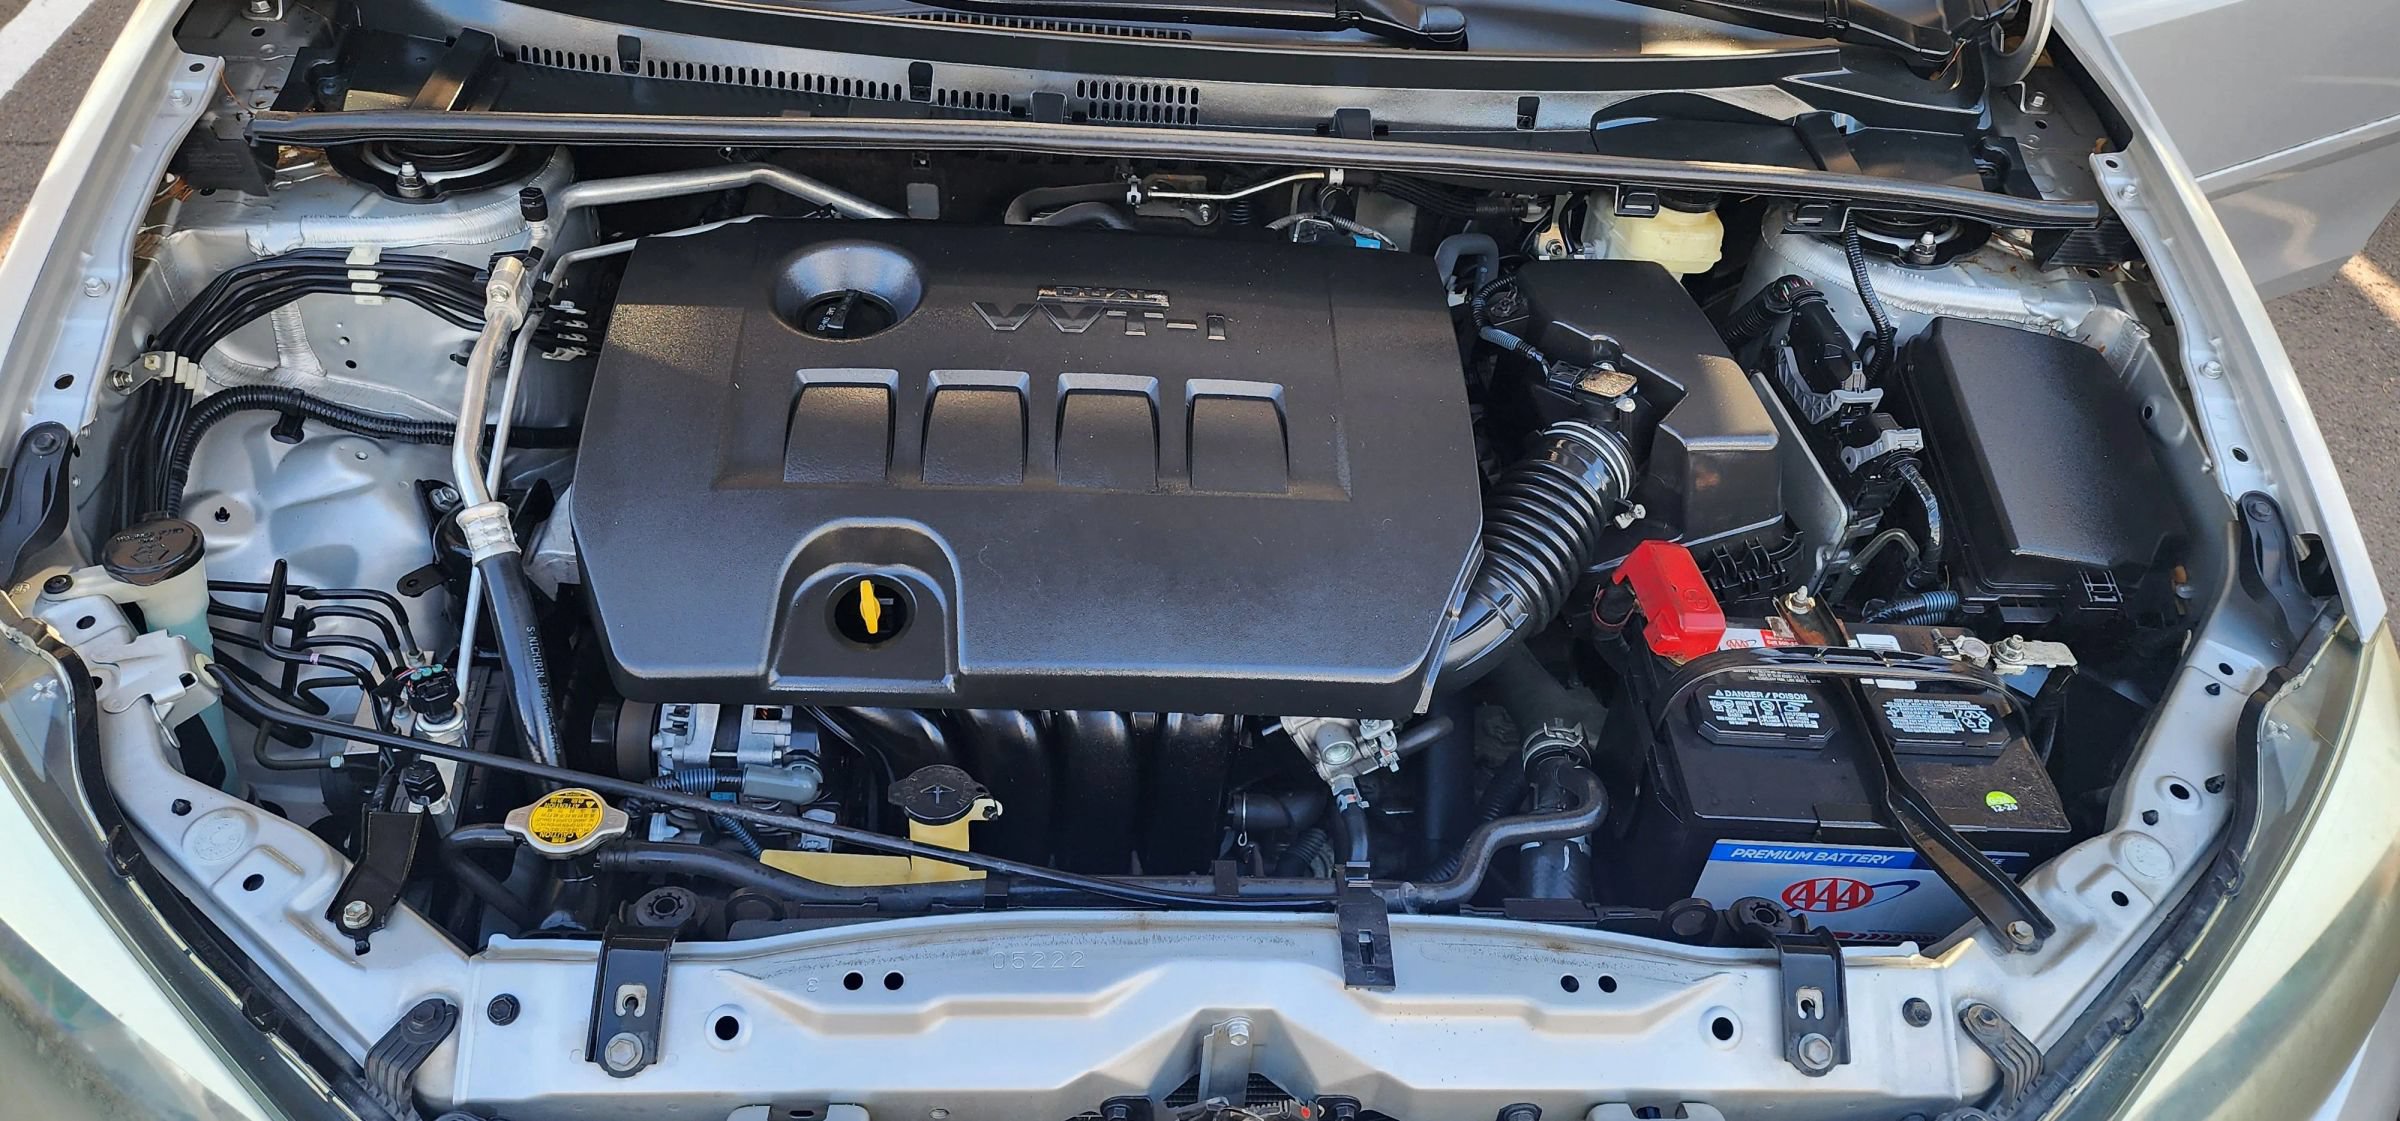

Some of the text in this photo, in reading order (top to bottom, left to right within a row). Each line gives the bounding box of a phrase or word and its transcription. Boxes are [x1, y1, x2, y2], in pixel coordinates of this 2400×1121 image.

[1056, 286, 1156, 300] DUAL
[1724, 689, 1762, 698] DANGER
[1772, 692, 1808, 700] POISON
[1731, 848, 1895, 864] PREMIUM BATTERY
[1782, 877, 1874, 912] AAA
[992, 951, 1086, 969] 05222
